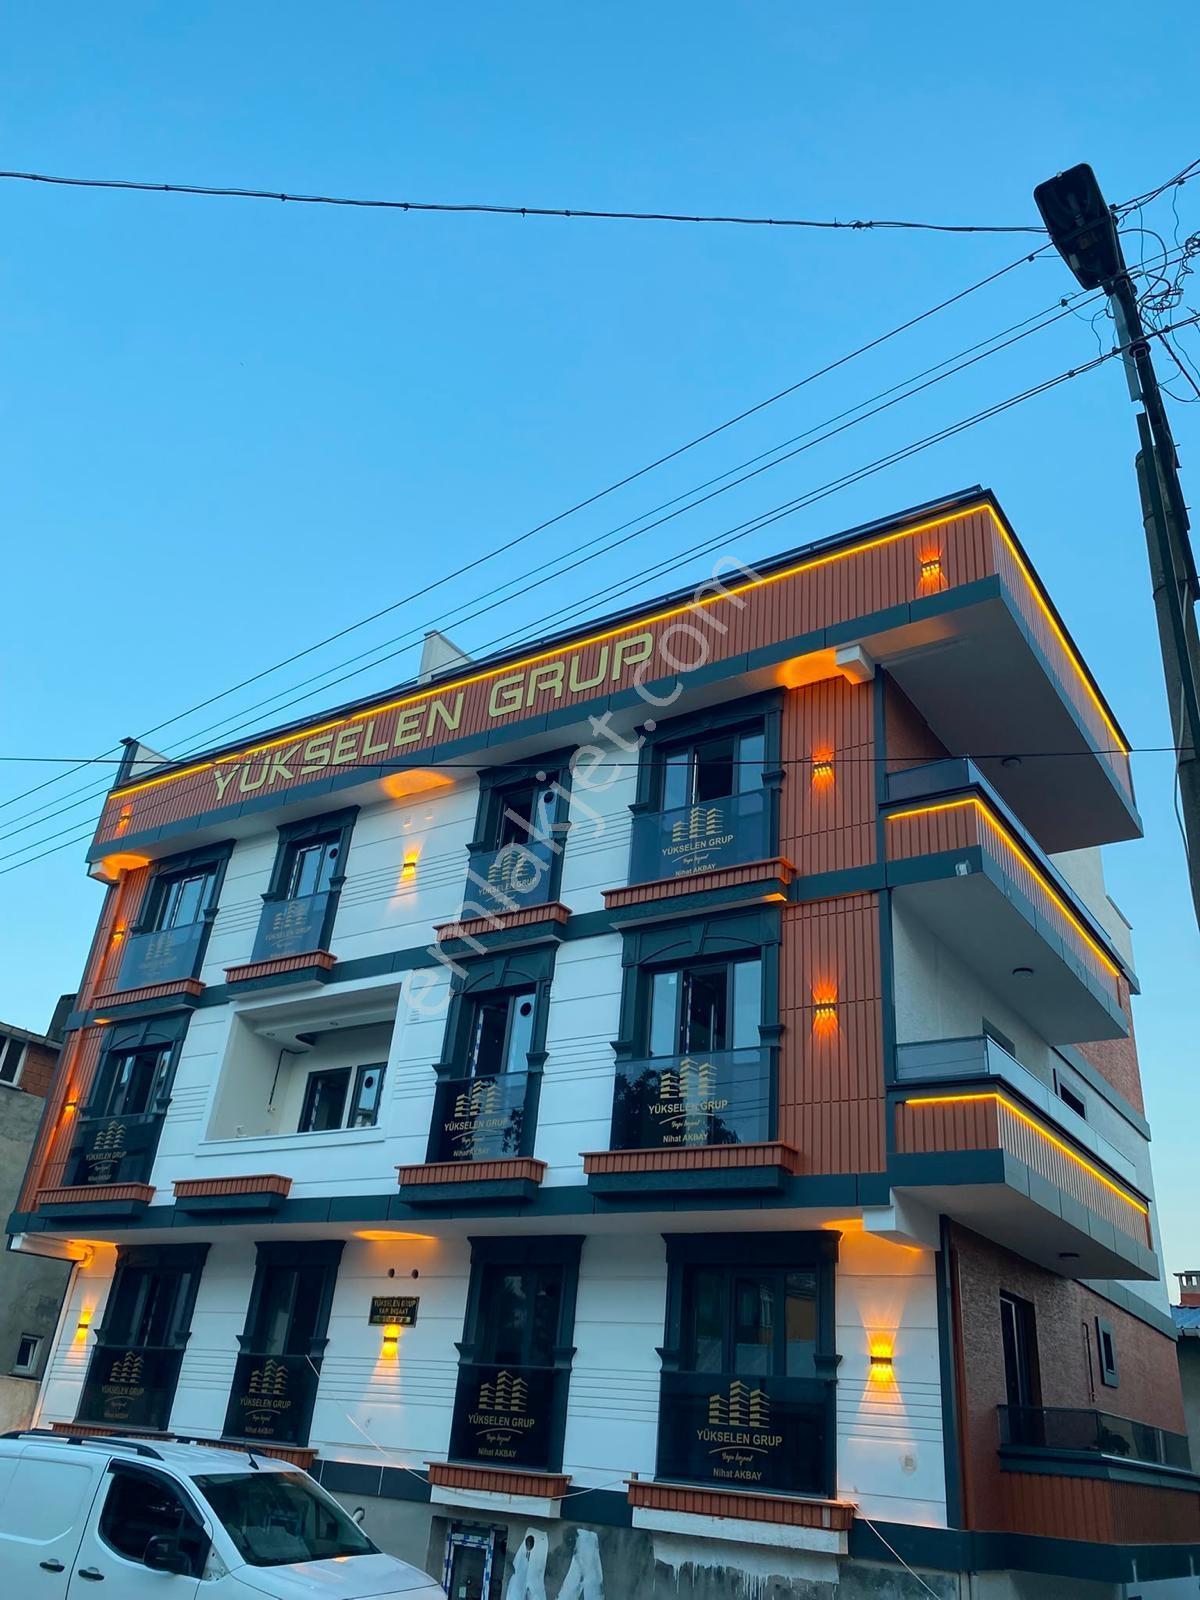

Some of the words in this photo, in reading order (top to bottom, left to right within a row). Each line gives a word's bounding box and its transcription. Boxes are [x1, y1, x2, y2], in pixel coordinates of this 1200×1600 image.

[213, 692, 464, 802] YÜKSELEN
[488, 632, 653, 718] GRUP
[709, 835, 733, 846] GRUP
[701, 1100, 727, 1111] GRUP
[445, 1119, 485, 1131] YÜKSELEN
[662, 1134, 681, 1143] Nihat
[468, 1413, 510, 1426] YÜKSELEN
[512, 1417, 535, 1427] GRUP
[697, 1429, 750, 1444] YÜKSELEN
[753, 1435, 782, 1446] GRUP
[713, 1467, 733, 1479] Nihat
[734, 1470, 762, 1481] AKBAY
